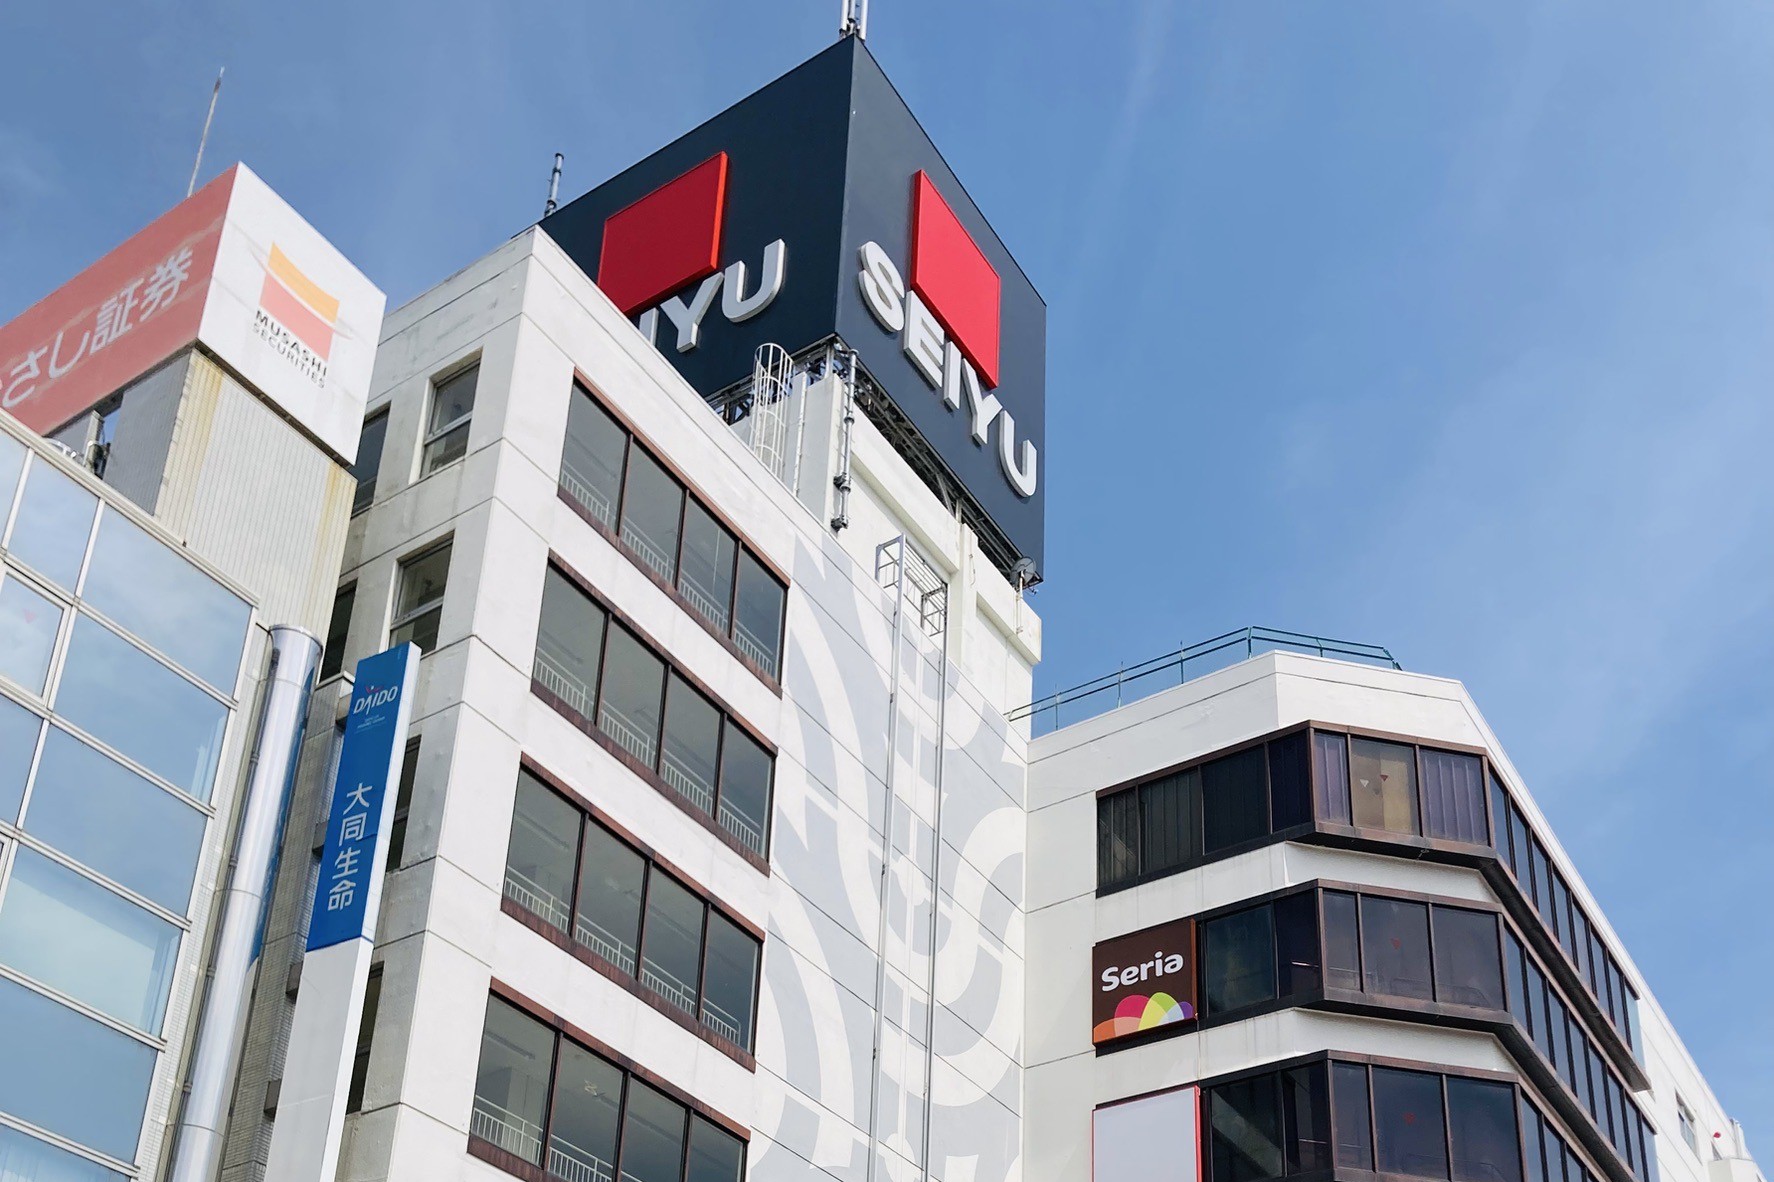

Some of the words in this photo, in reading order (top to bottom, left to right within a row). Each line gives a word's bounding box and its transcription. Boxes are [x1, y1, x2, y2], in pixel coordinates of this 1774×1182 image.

[0, 246, 193, 408] さし証券
[253, 322, 325, 388] SECURITIES
[256, 310, 327, 376] MUSASHI
[858, 241, 1038, 498] SEIYU
[353, 685, 398, 715] DAIDO
[327, 782, 372, 911] 大同生命
[1101, 951, 1184, 992] Seria
